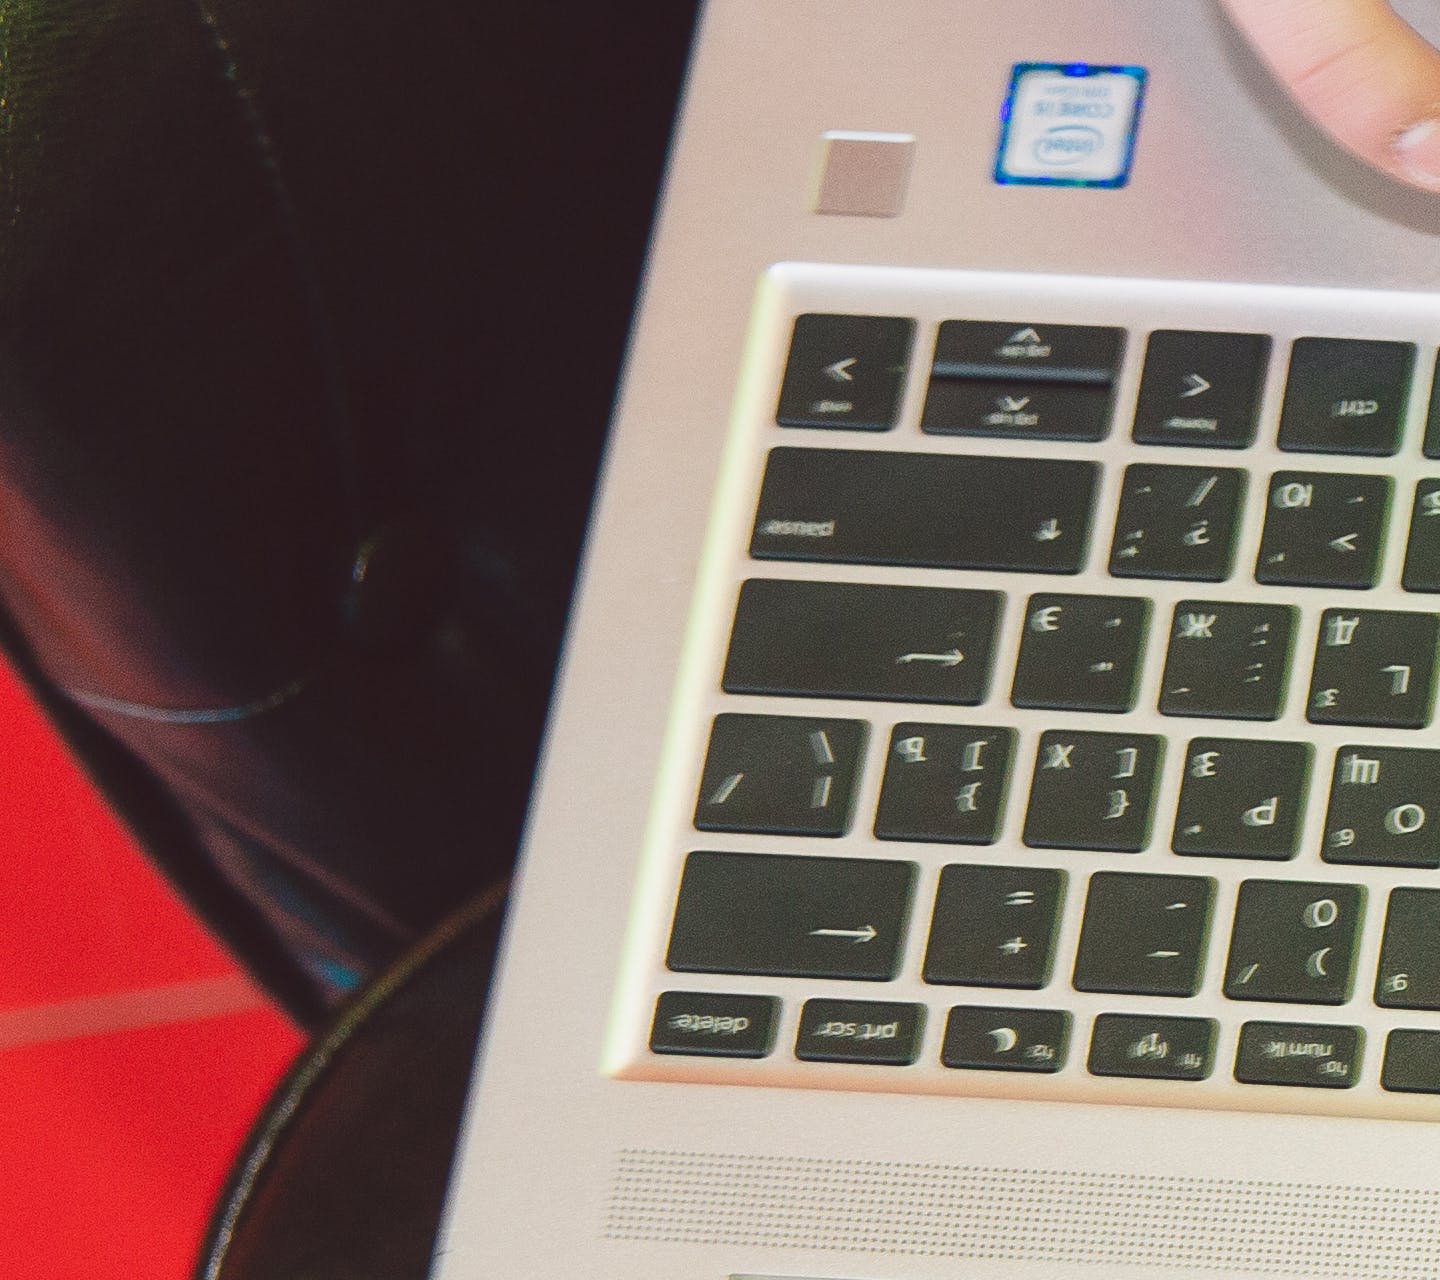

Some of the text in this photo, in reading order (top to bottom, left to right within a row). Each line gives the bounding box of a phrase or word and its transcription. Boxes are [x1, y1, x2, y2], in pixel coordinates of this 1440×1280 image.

[1334, 398, 1380, 419] ctrl
[1271, 481, 1313, 510] Ю
[760, 519, 836, 538] pause
[1176, 612, 1218, 639] Ж
[1326, 615, 1360, 647] Д
[1380, 664, 1411, 695] L
[1241, 795, 1280, 827] P
[1384, 972, 1409, 995] 9
[669, 1013, 750, 1034] delete
[814, 1020, 898, 1040] prt scr
